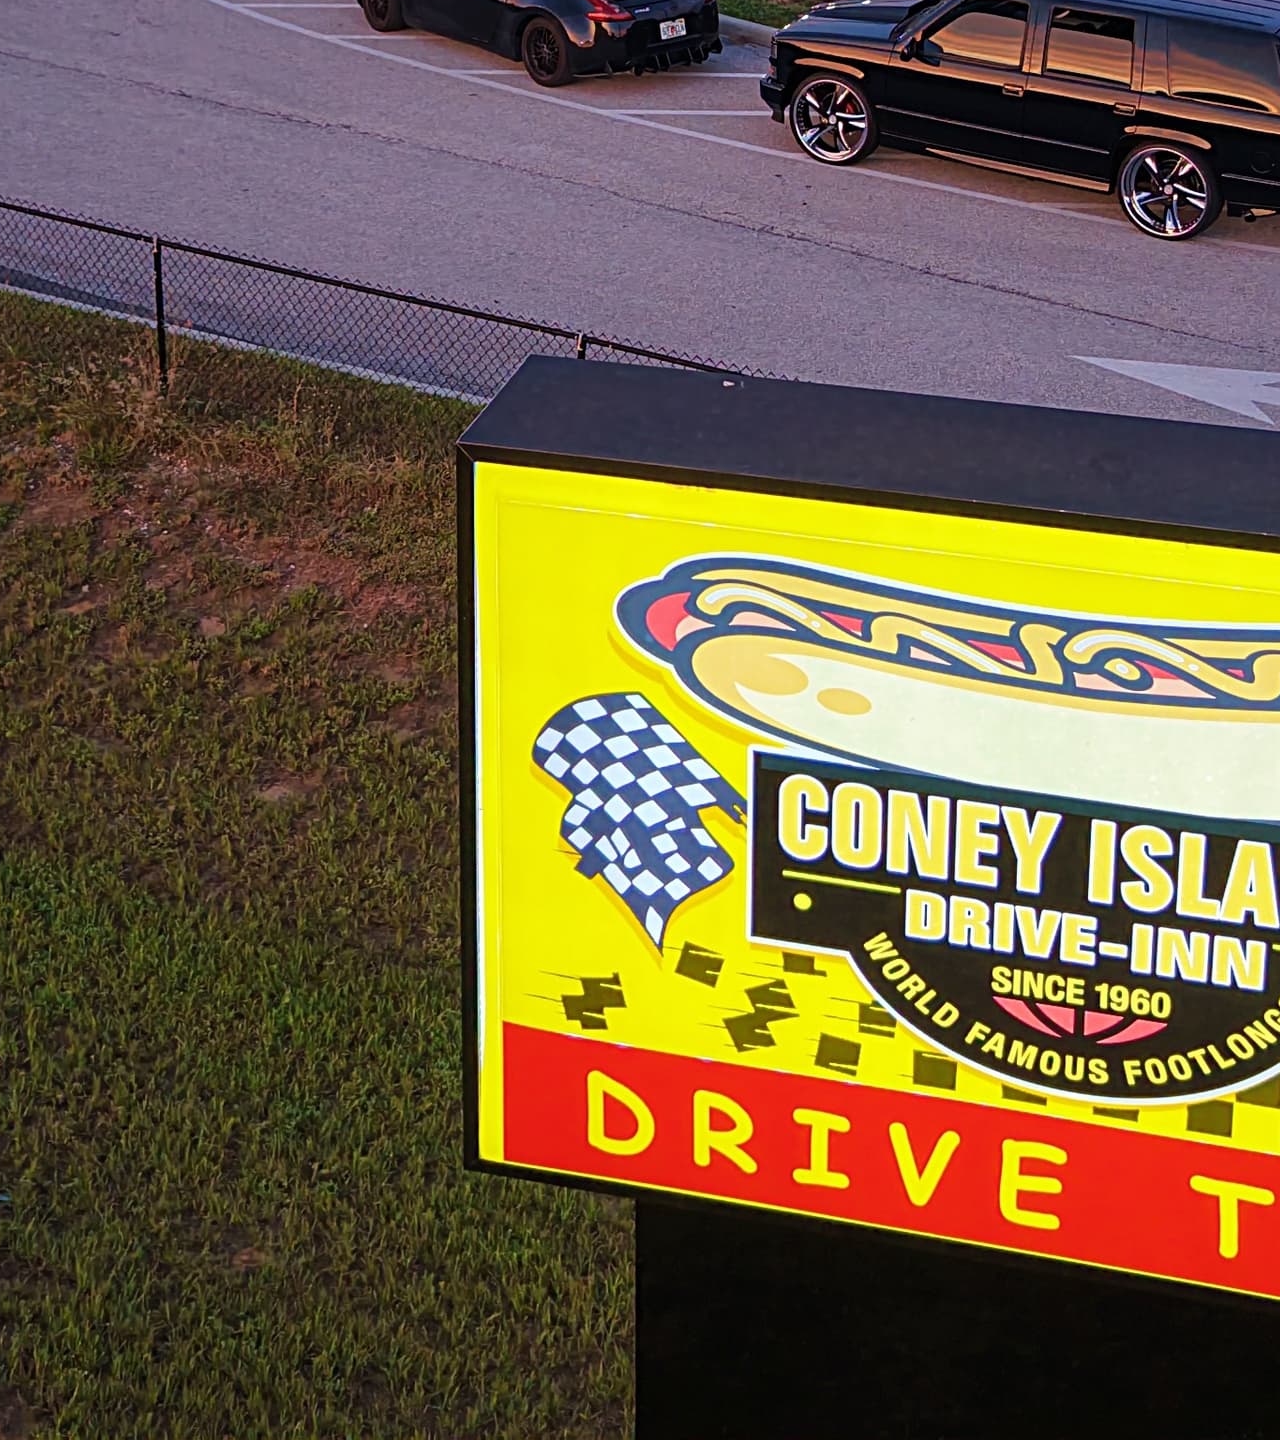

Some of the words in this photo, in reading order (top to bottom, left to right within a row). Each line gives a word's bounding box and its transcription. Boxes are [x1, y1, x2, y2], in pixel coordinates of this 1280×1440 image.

[778, 773, 1063, 895] CONEY
[904, 888, 1267, 992] DRIVE-INN
[991, 966, 1086, 1007] SINCE
[1093, 982, 1172, 1020] 1960
[862, 931, 961, 1029] WORLD
[964, 1020, 1112, 1086] FAMOUS
[586, 1069, 1069, 1231] DRIVE
